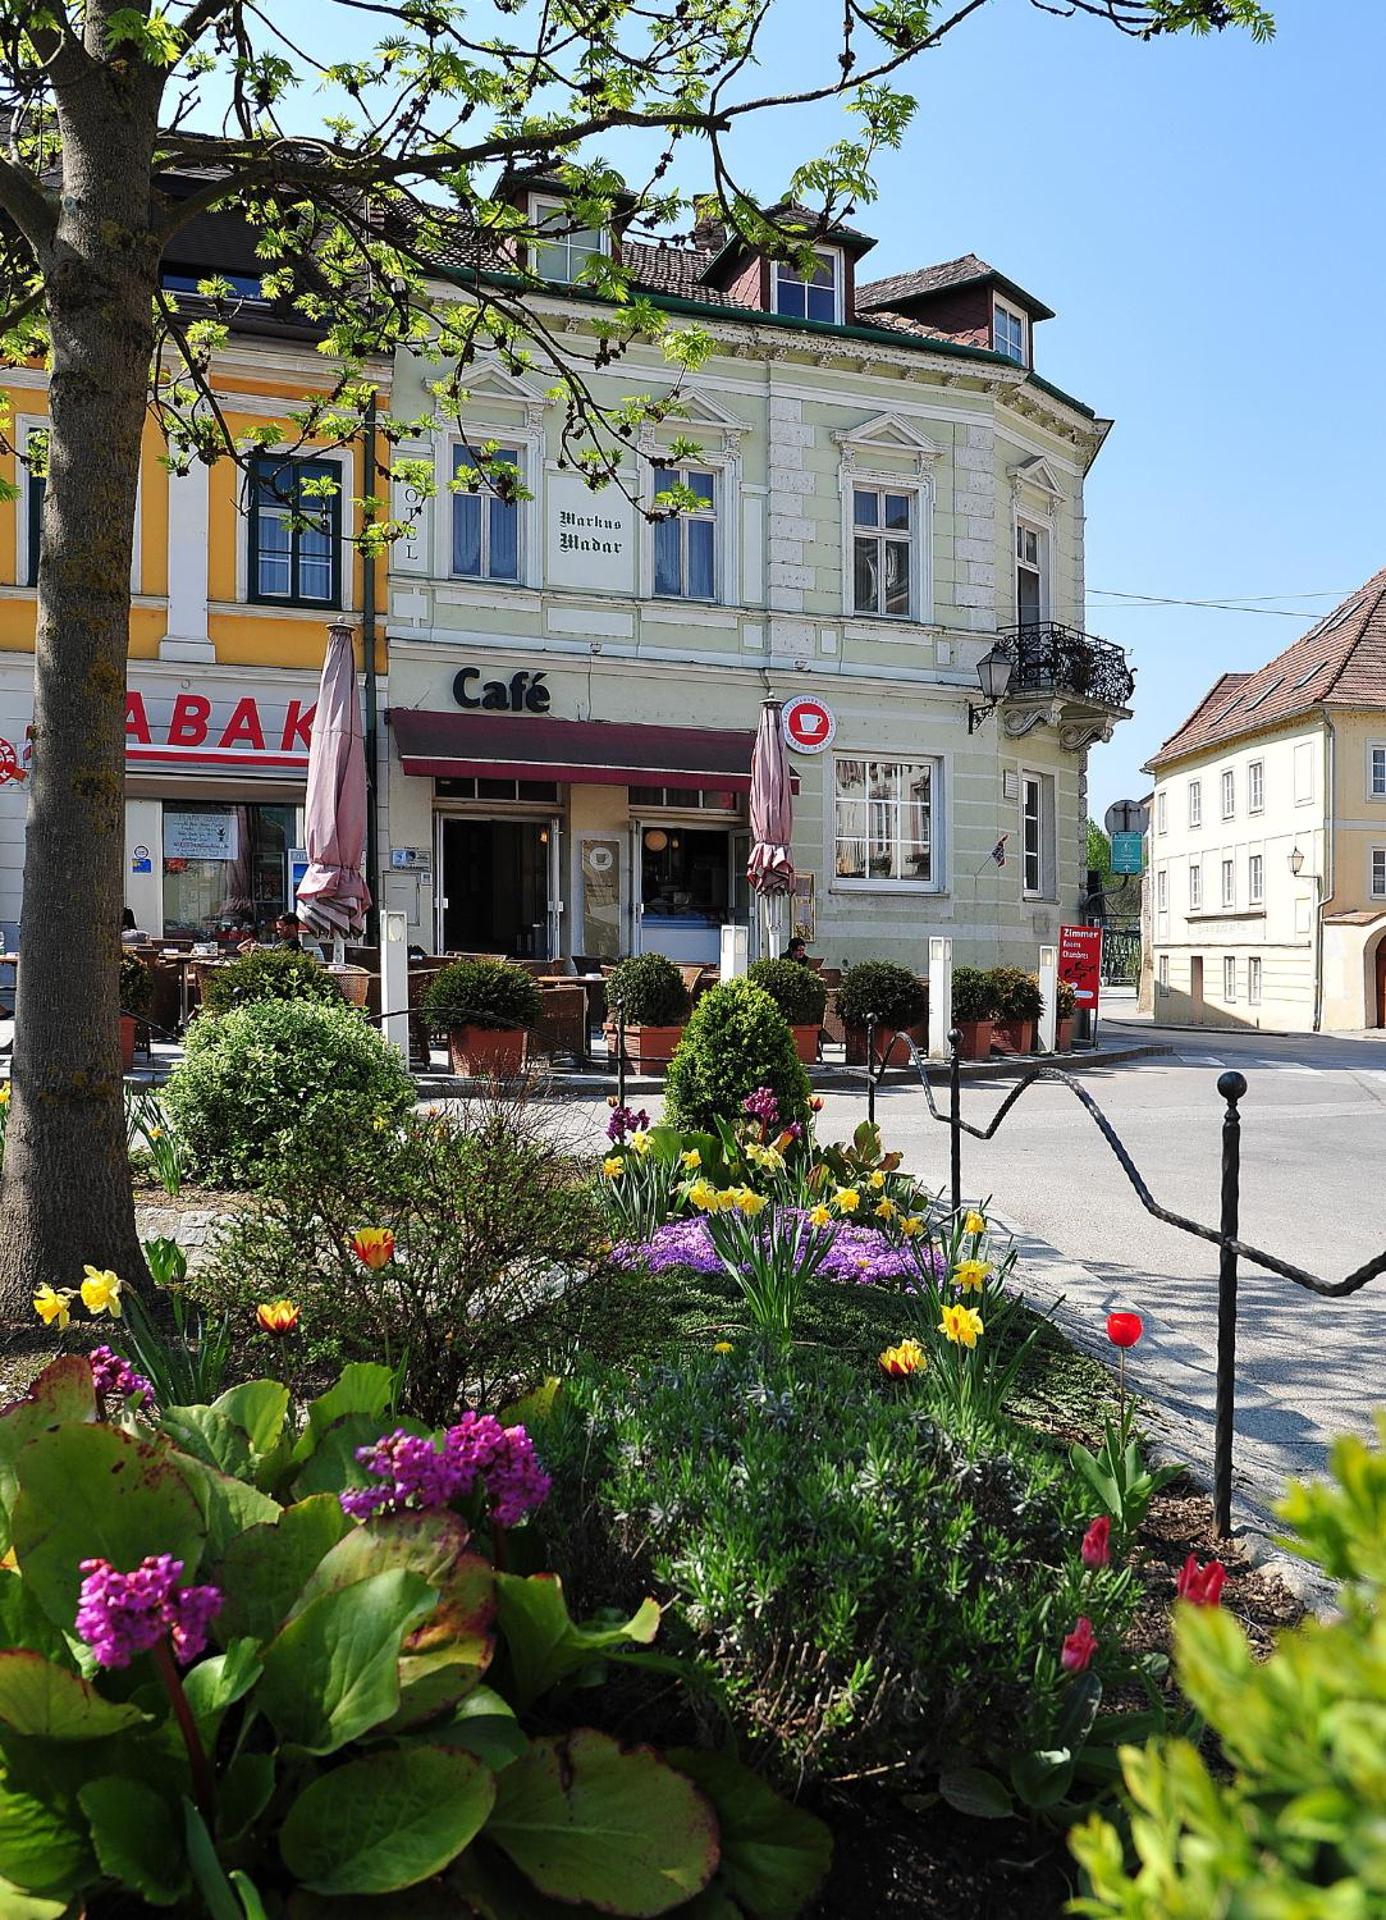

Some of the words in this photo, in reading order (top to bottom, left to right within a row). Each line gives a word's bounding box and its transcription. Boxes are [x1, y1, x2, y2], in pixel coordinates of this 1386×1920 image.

[405, 487, 418, 560] OTEL
[560, 511, 622, 529] Markus
[560, 533, 622, 553] Madar
[453, 667, 551, 713] Café
[125, 691, 317, 751] ABAK
[1063, 928, 1099, 939] Zimmer
